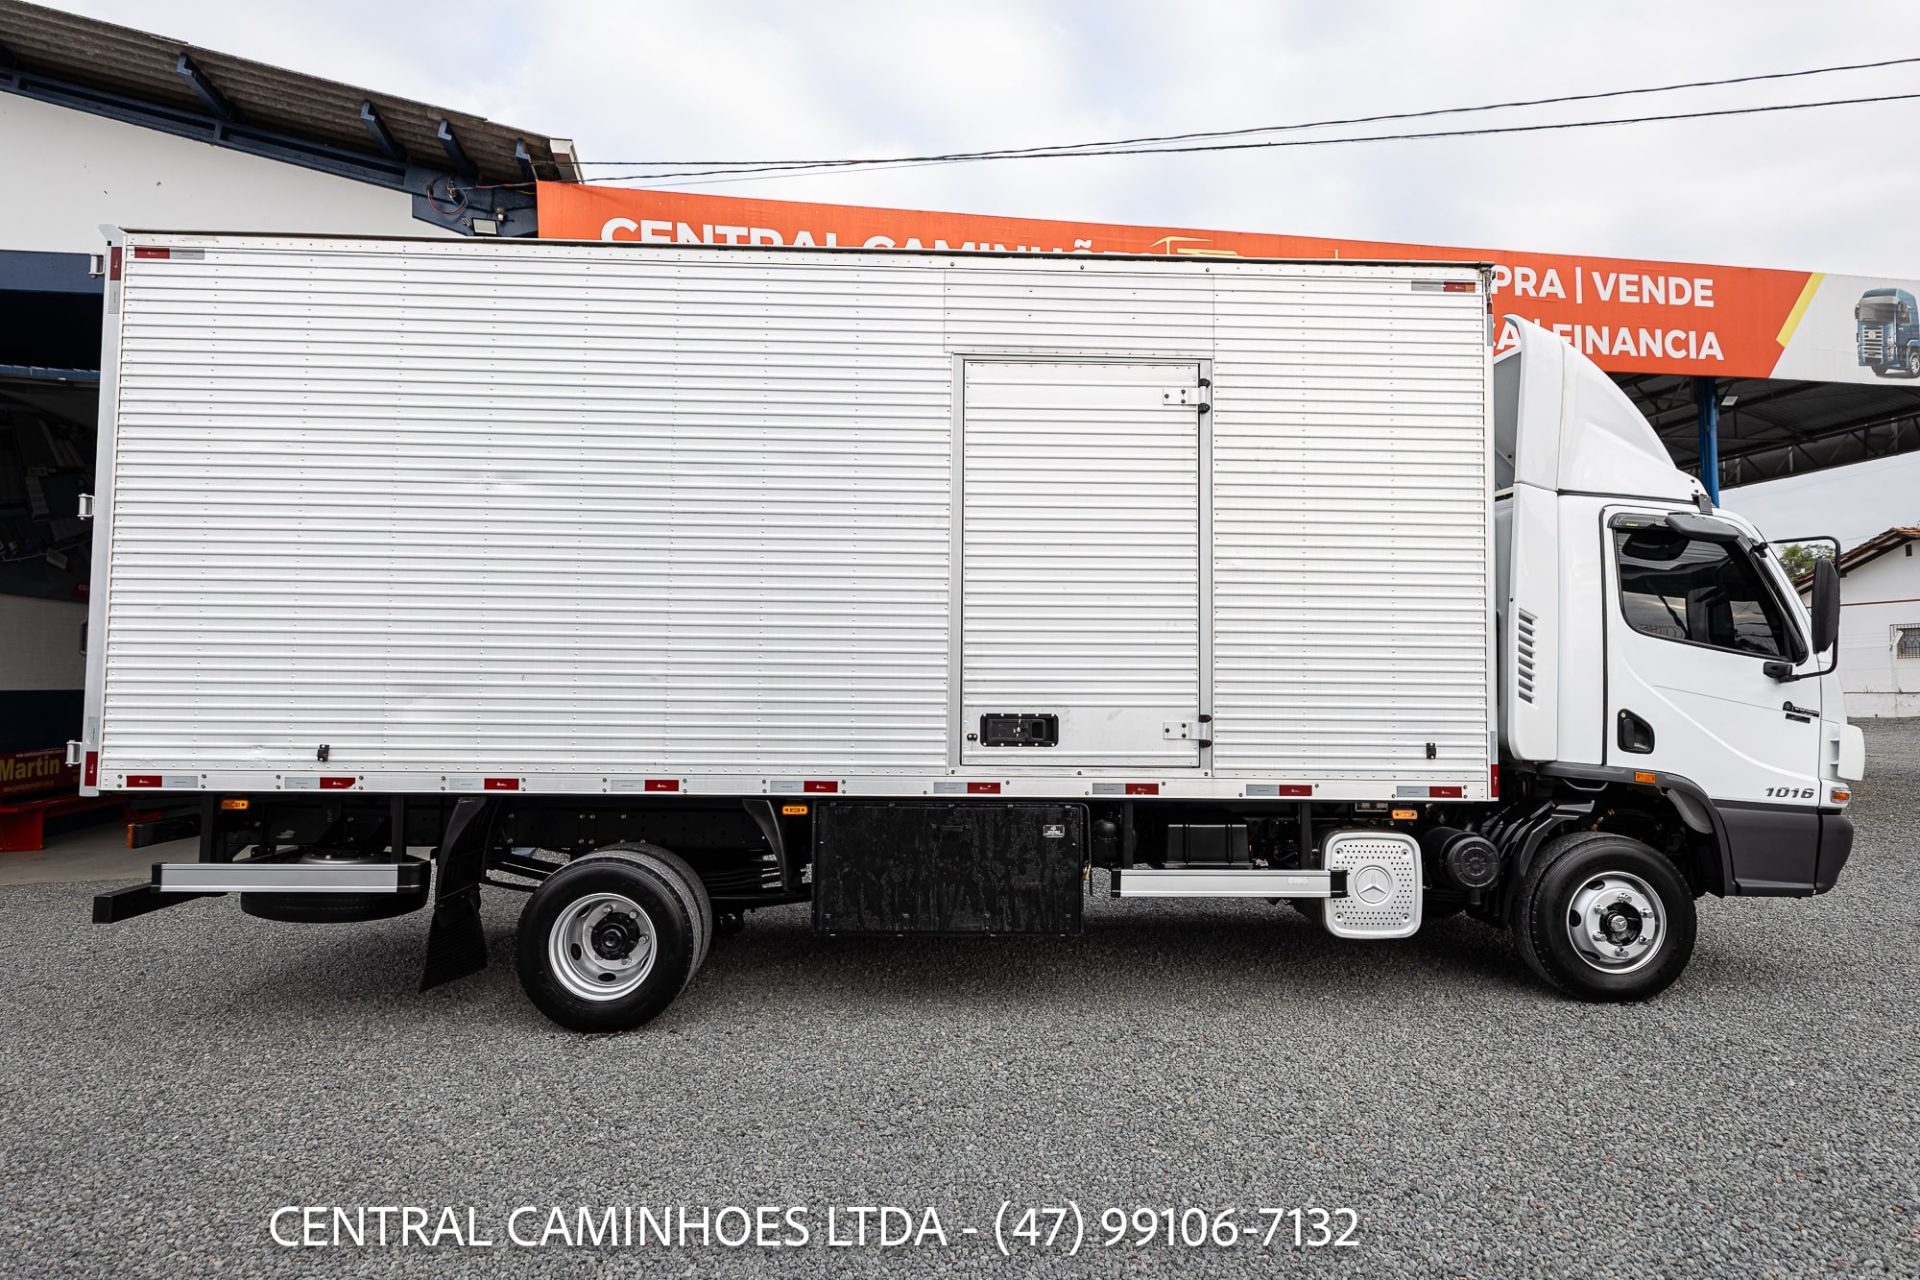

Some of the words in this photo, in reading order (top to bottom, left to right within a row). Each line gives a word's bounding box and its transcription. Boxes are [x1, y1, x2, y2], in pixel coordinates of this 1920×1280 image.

[1591, 271, 1715, 308] VENDE
[1552, 323, 1725, 361] FINANCIA
[1765, 787, 1815, 799] 1016
